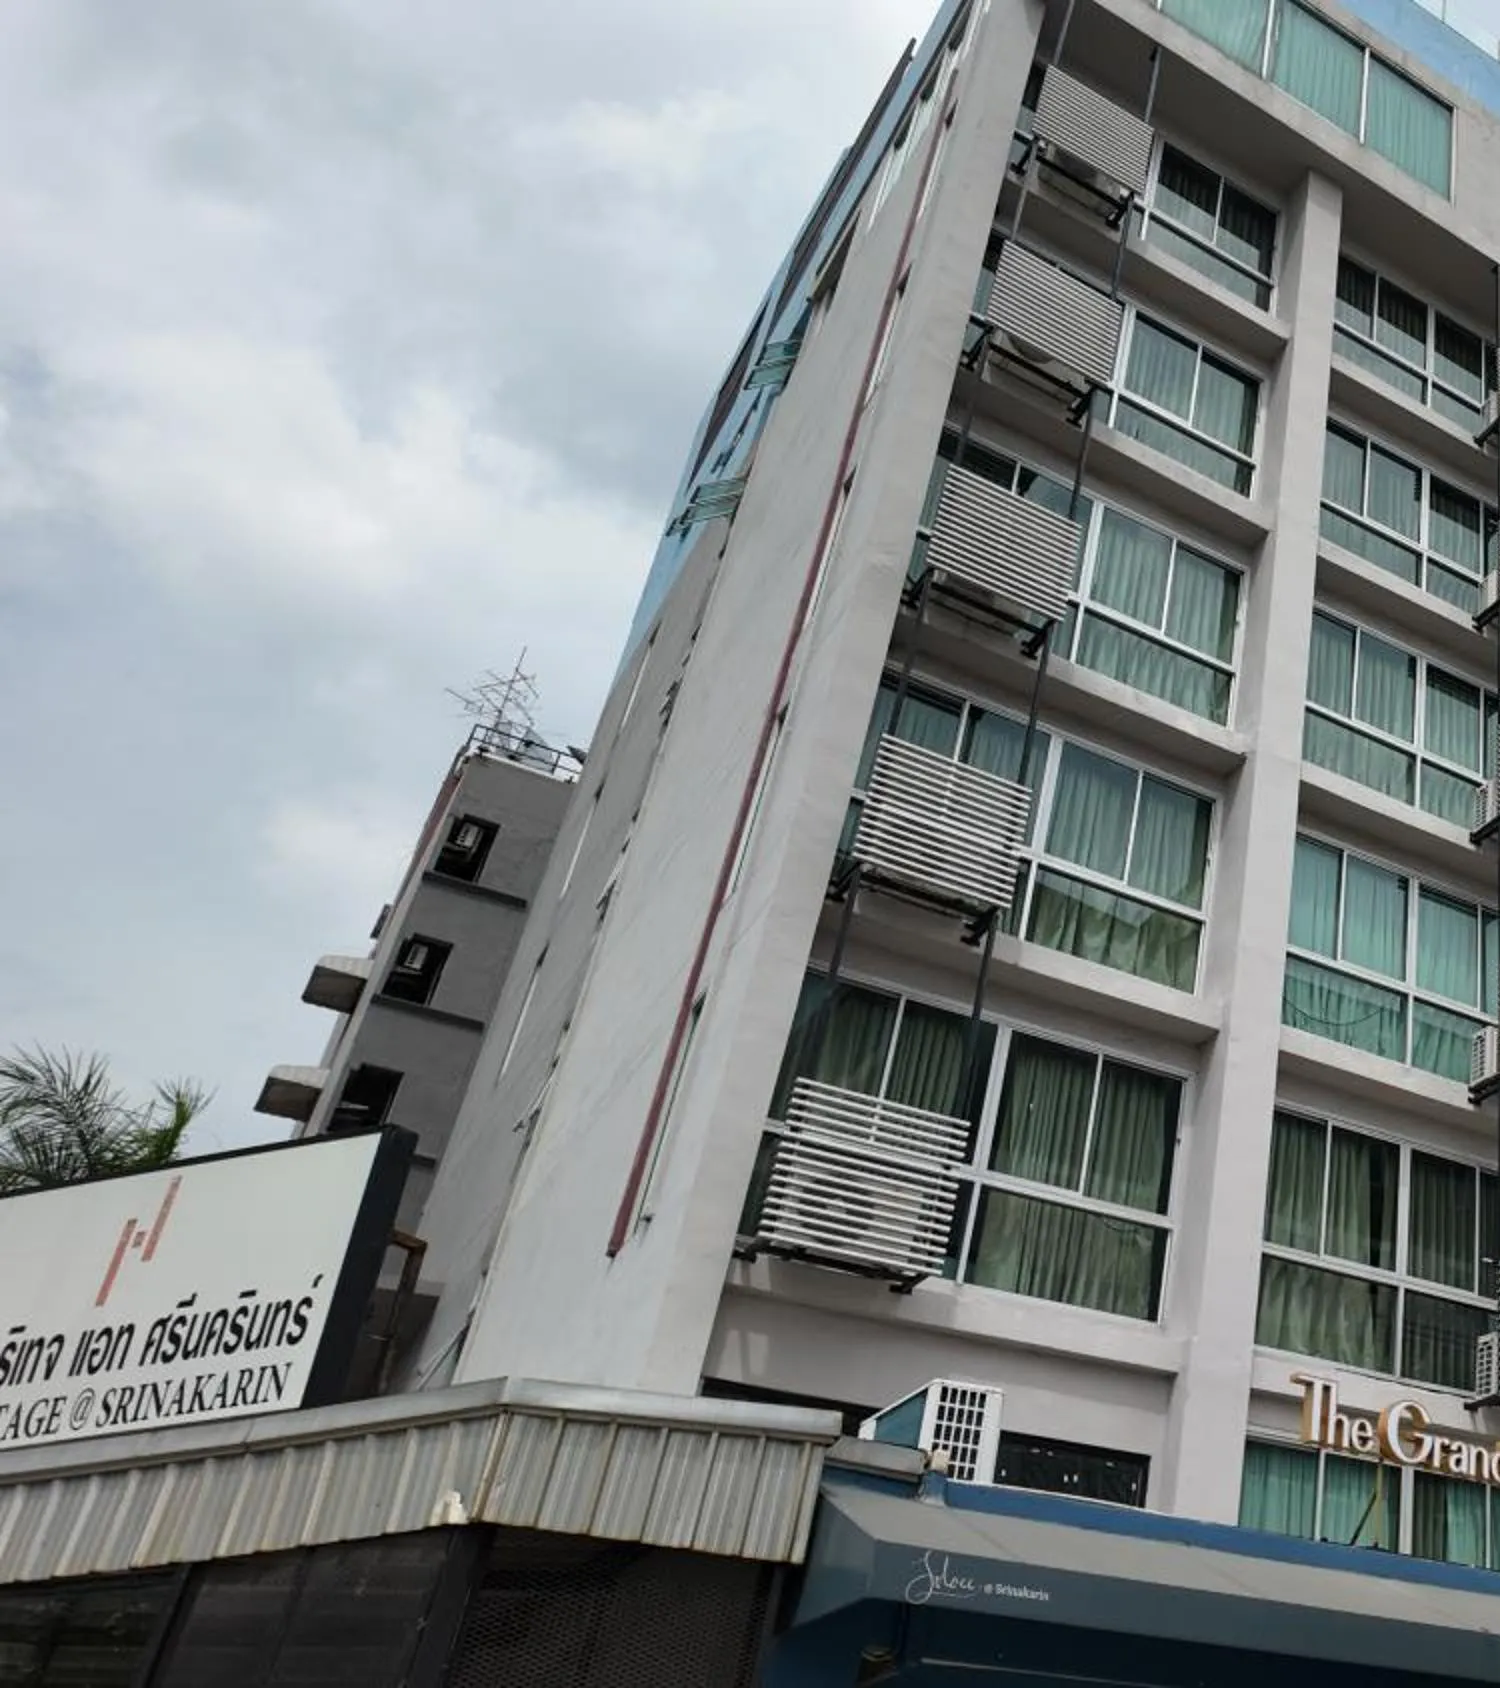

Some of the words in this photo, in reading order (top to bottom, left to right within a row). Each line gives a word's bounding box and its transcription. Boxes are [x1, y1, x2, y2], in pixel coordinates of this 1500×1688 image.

[67, 1323, 135, 1377] แอท
[138, 1273, 324, 1367] ศรีนครินทร์
[95, 1362, 293, 1428] SRINAKARIN
[1291, 1373, 1374, 1451] The
